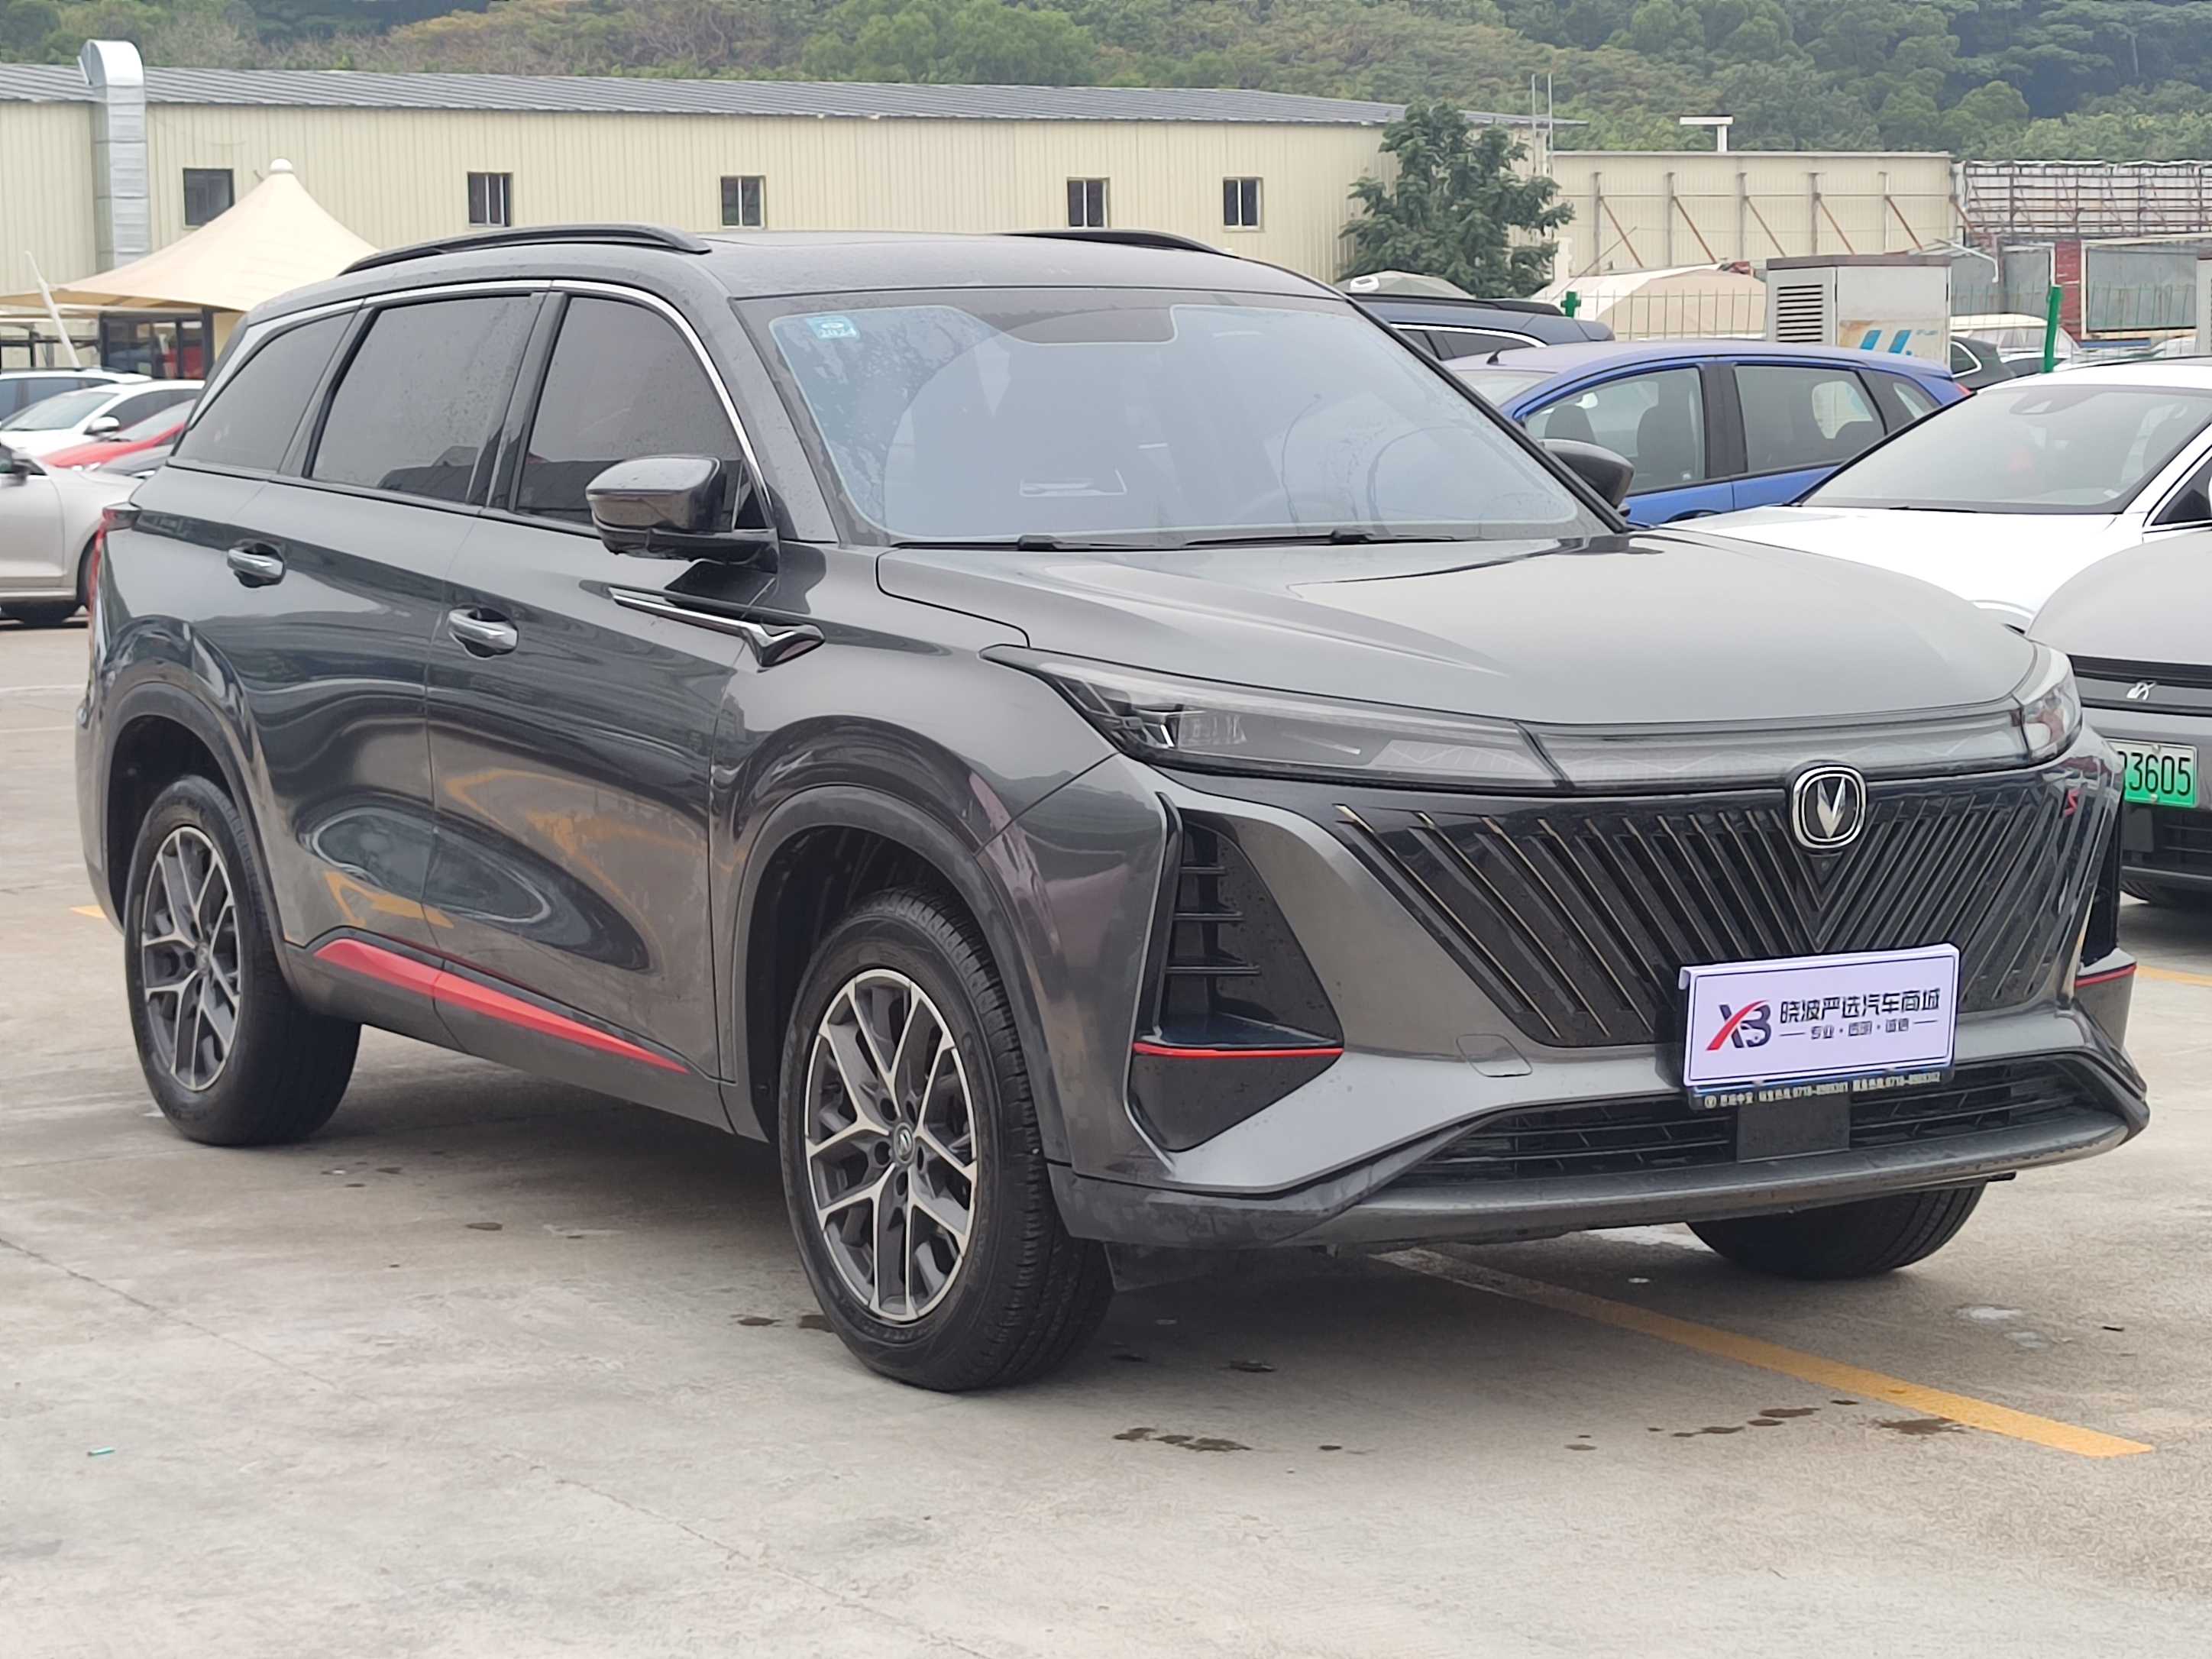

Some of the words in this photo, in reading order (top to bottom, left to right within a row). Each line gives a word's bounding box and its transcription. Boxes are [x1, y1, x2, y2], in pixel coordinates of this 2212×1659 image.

[1780, 987, 1941, 1024] 晓波严选汽车商城
